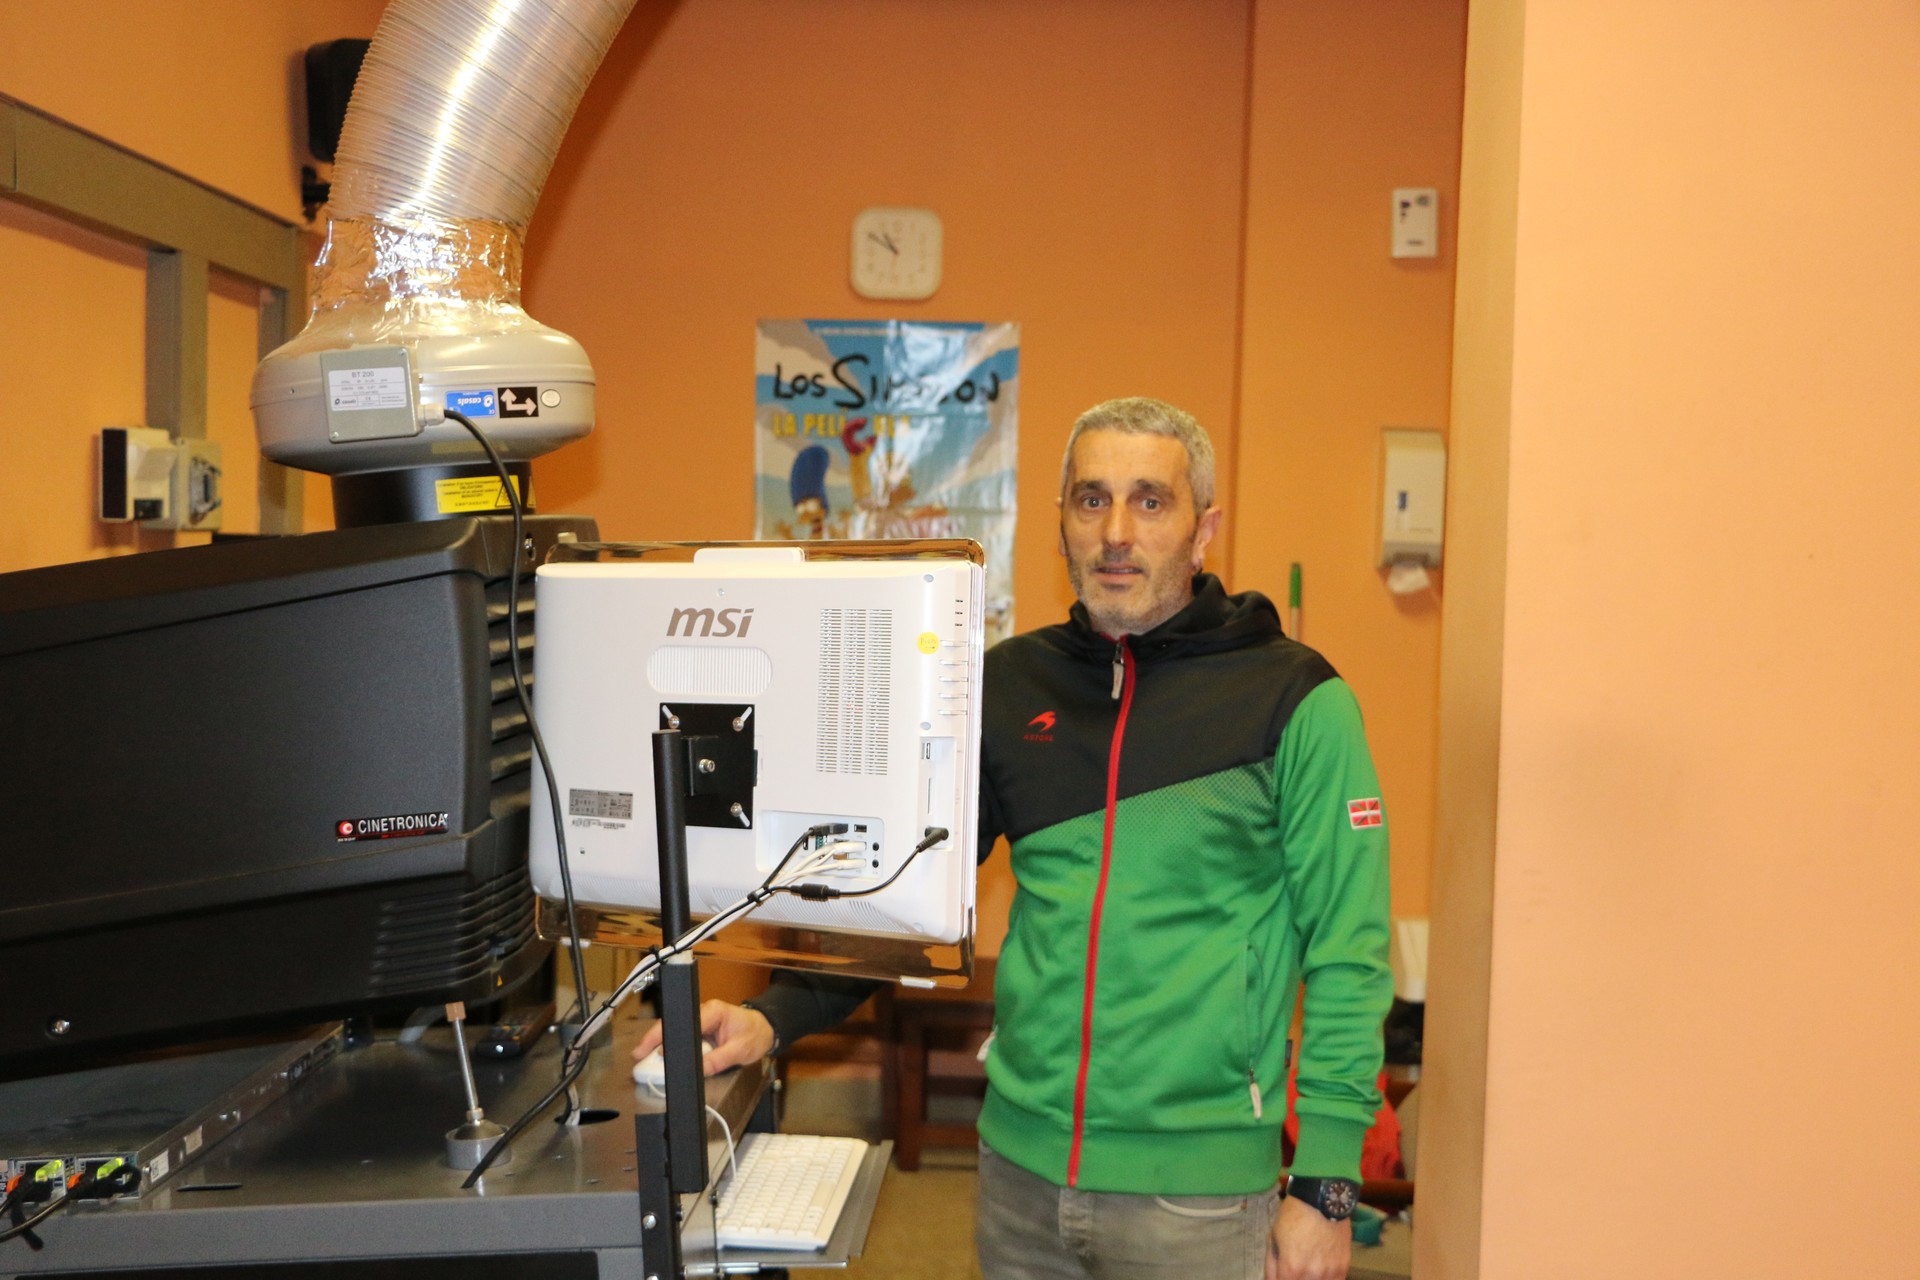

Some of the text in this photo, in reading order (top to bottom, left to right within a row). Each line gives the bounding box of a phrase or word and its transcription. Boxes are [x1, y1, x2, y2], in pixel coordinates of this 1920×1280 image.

[773, 413, 797, 436] LA
[666, 607, 754, 638] msi
[358, 813, 448, 834] CINETRONICA
